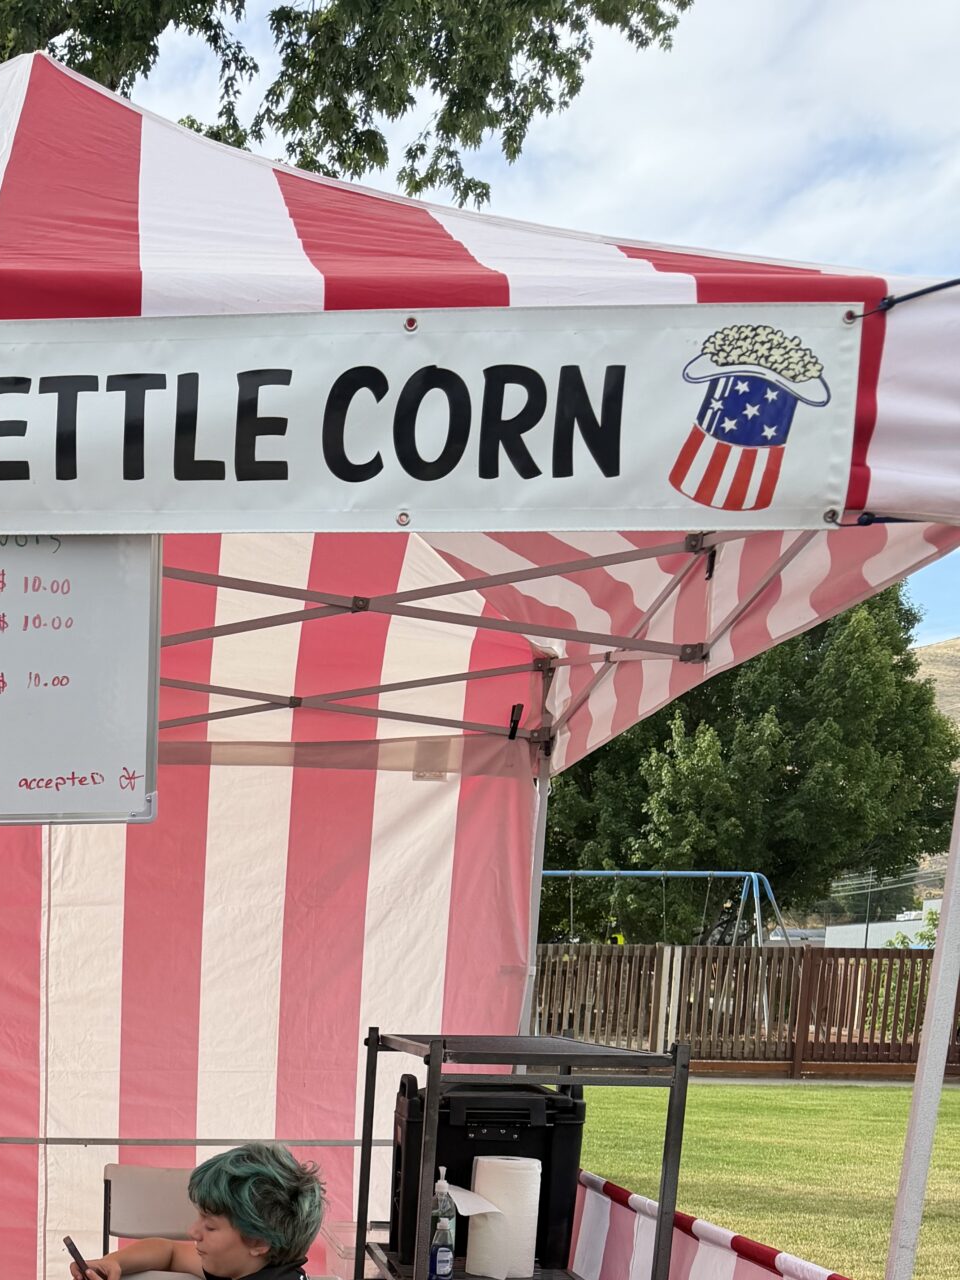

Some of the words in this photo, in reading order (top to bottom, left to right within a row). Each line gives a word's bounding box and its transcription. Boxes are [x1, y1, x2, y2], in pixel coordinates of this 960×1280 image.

[322, 364, 626, 482] CORN
[24, 576, 71, 595] 10.00
[23, 613, 74, 631] 10.00
[27, 672, 70, 689] 10.00
